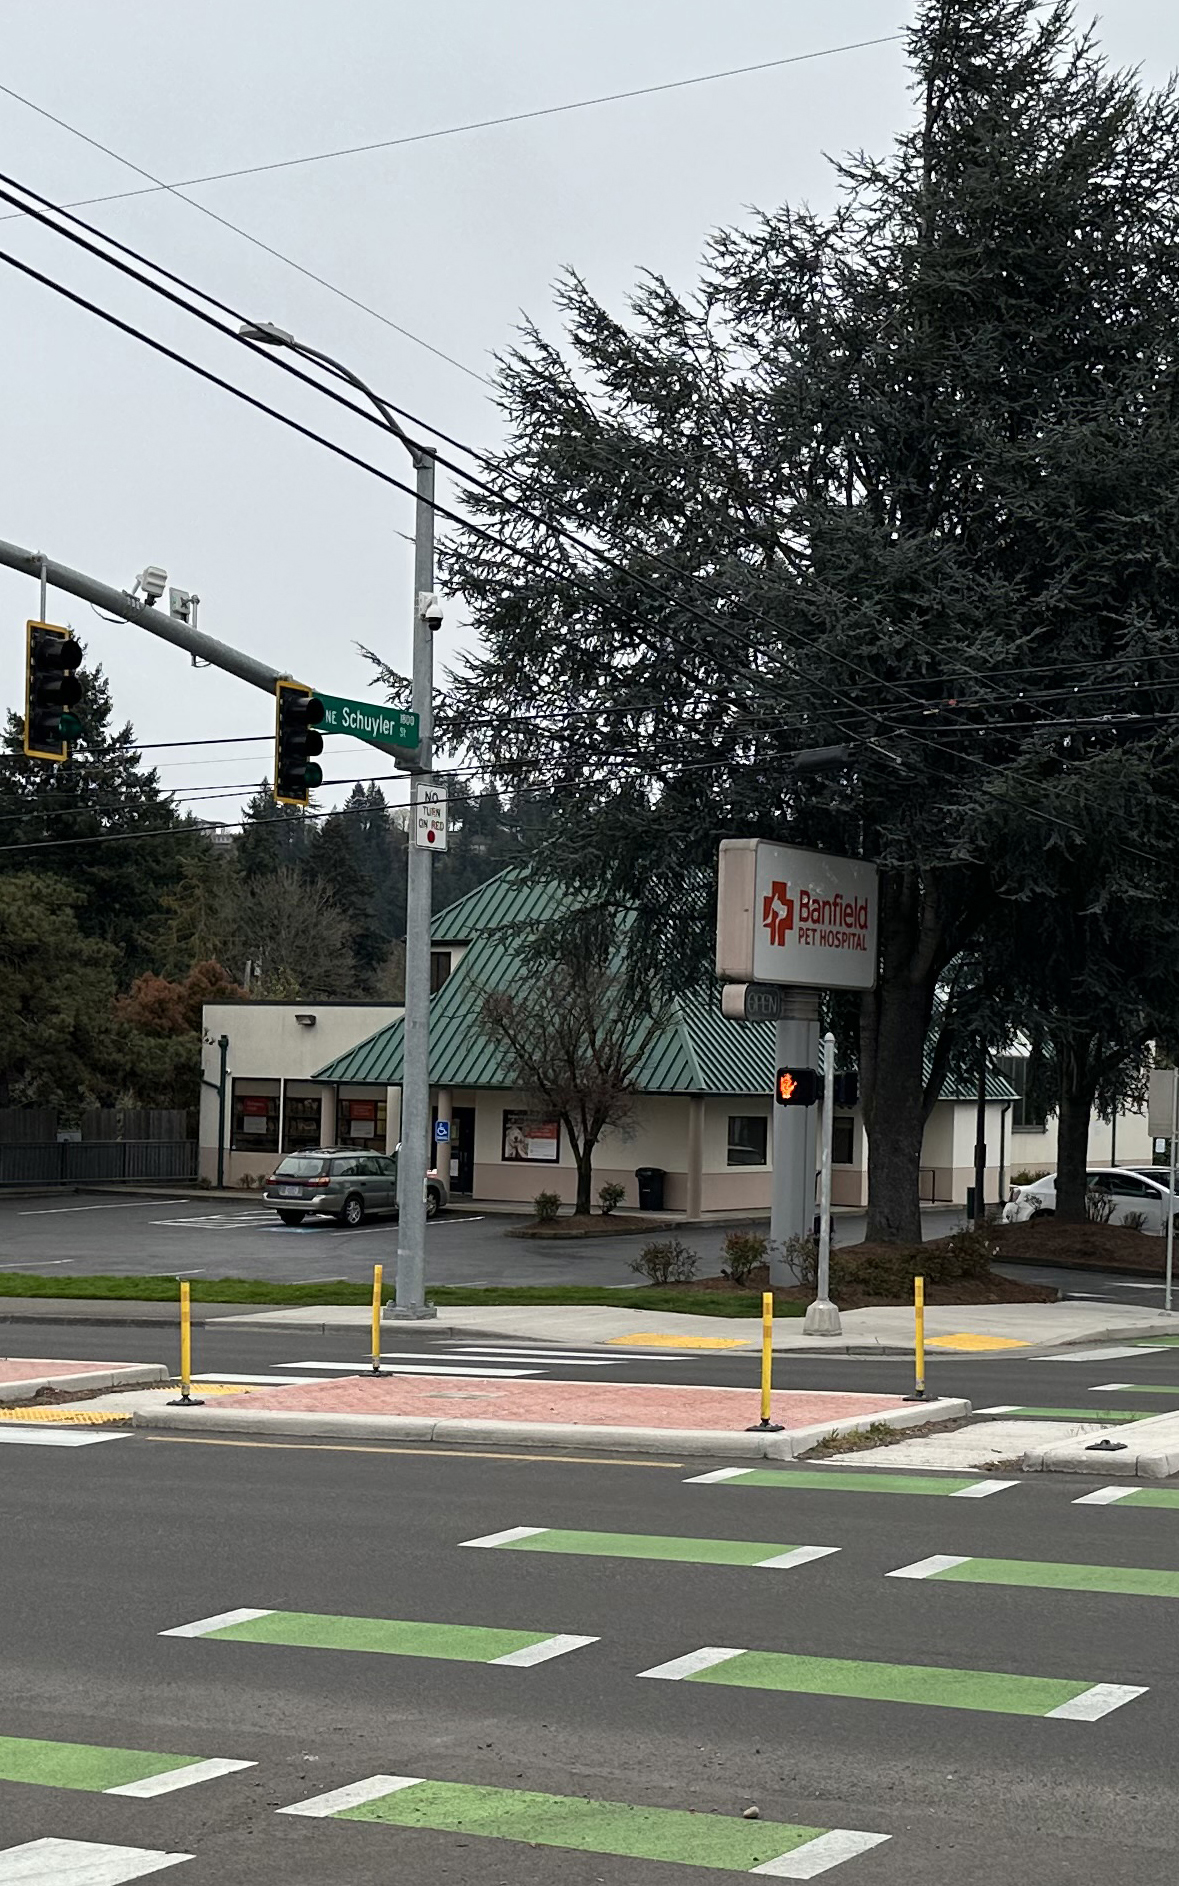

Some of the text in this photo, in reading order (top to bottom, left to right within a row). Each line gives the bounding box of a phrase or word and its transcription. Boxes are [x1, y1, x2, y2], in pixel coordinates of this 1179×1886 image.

[325, 707, 395, 737] NE Schuyler
[399, 726, 407, 738] St
[424, 790, 439, 804] NO
[423, 806, 441, 818] TURN
[418, 818, 445, 831] ON RED
[799, 889, 868, 930] Banfield
[798, 926, 868, 951] PET HOSPITAL
[747, 992, 777, 1014] OPEN
